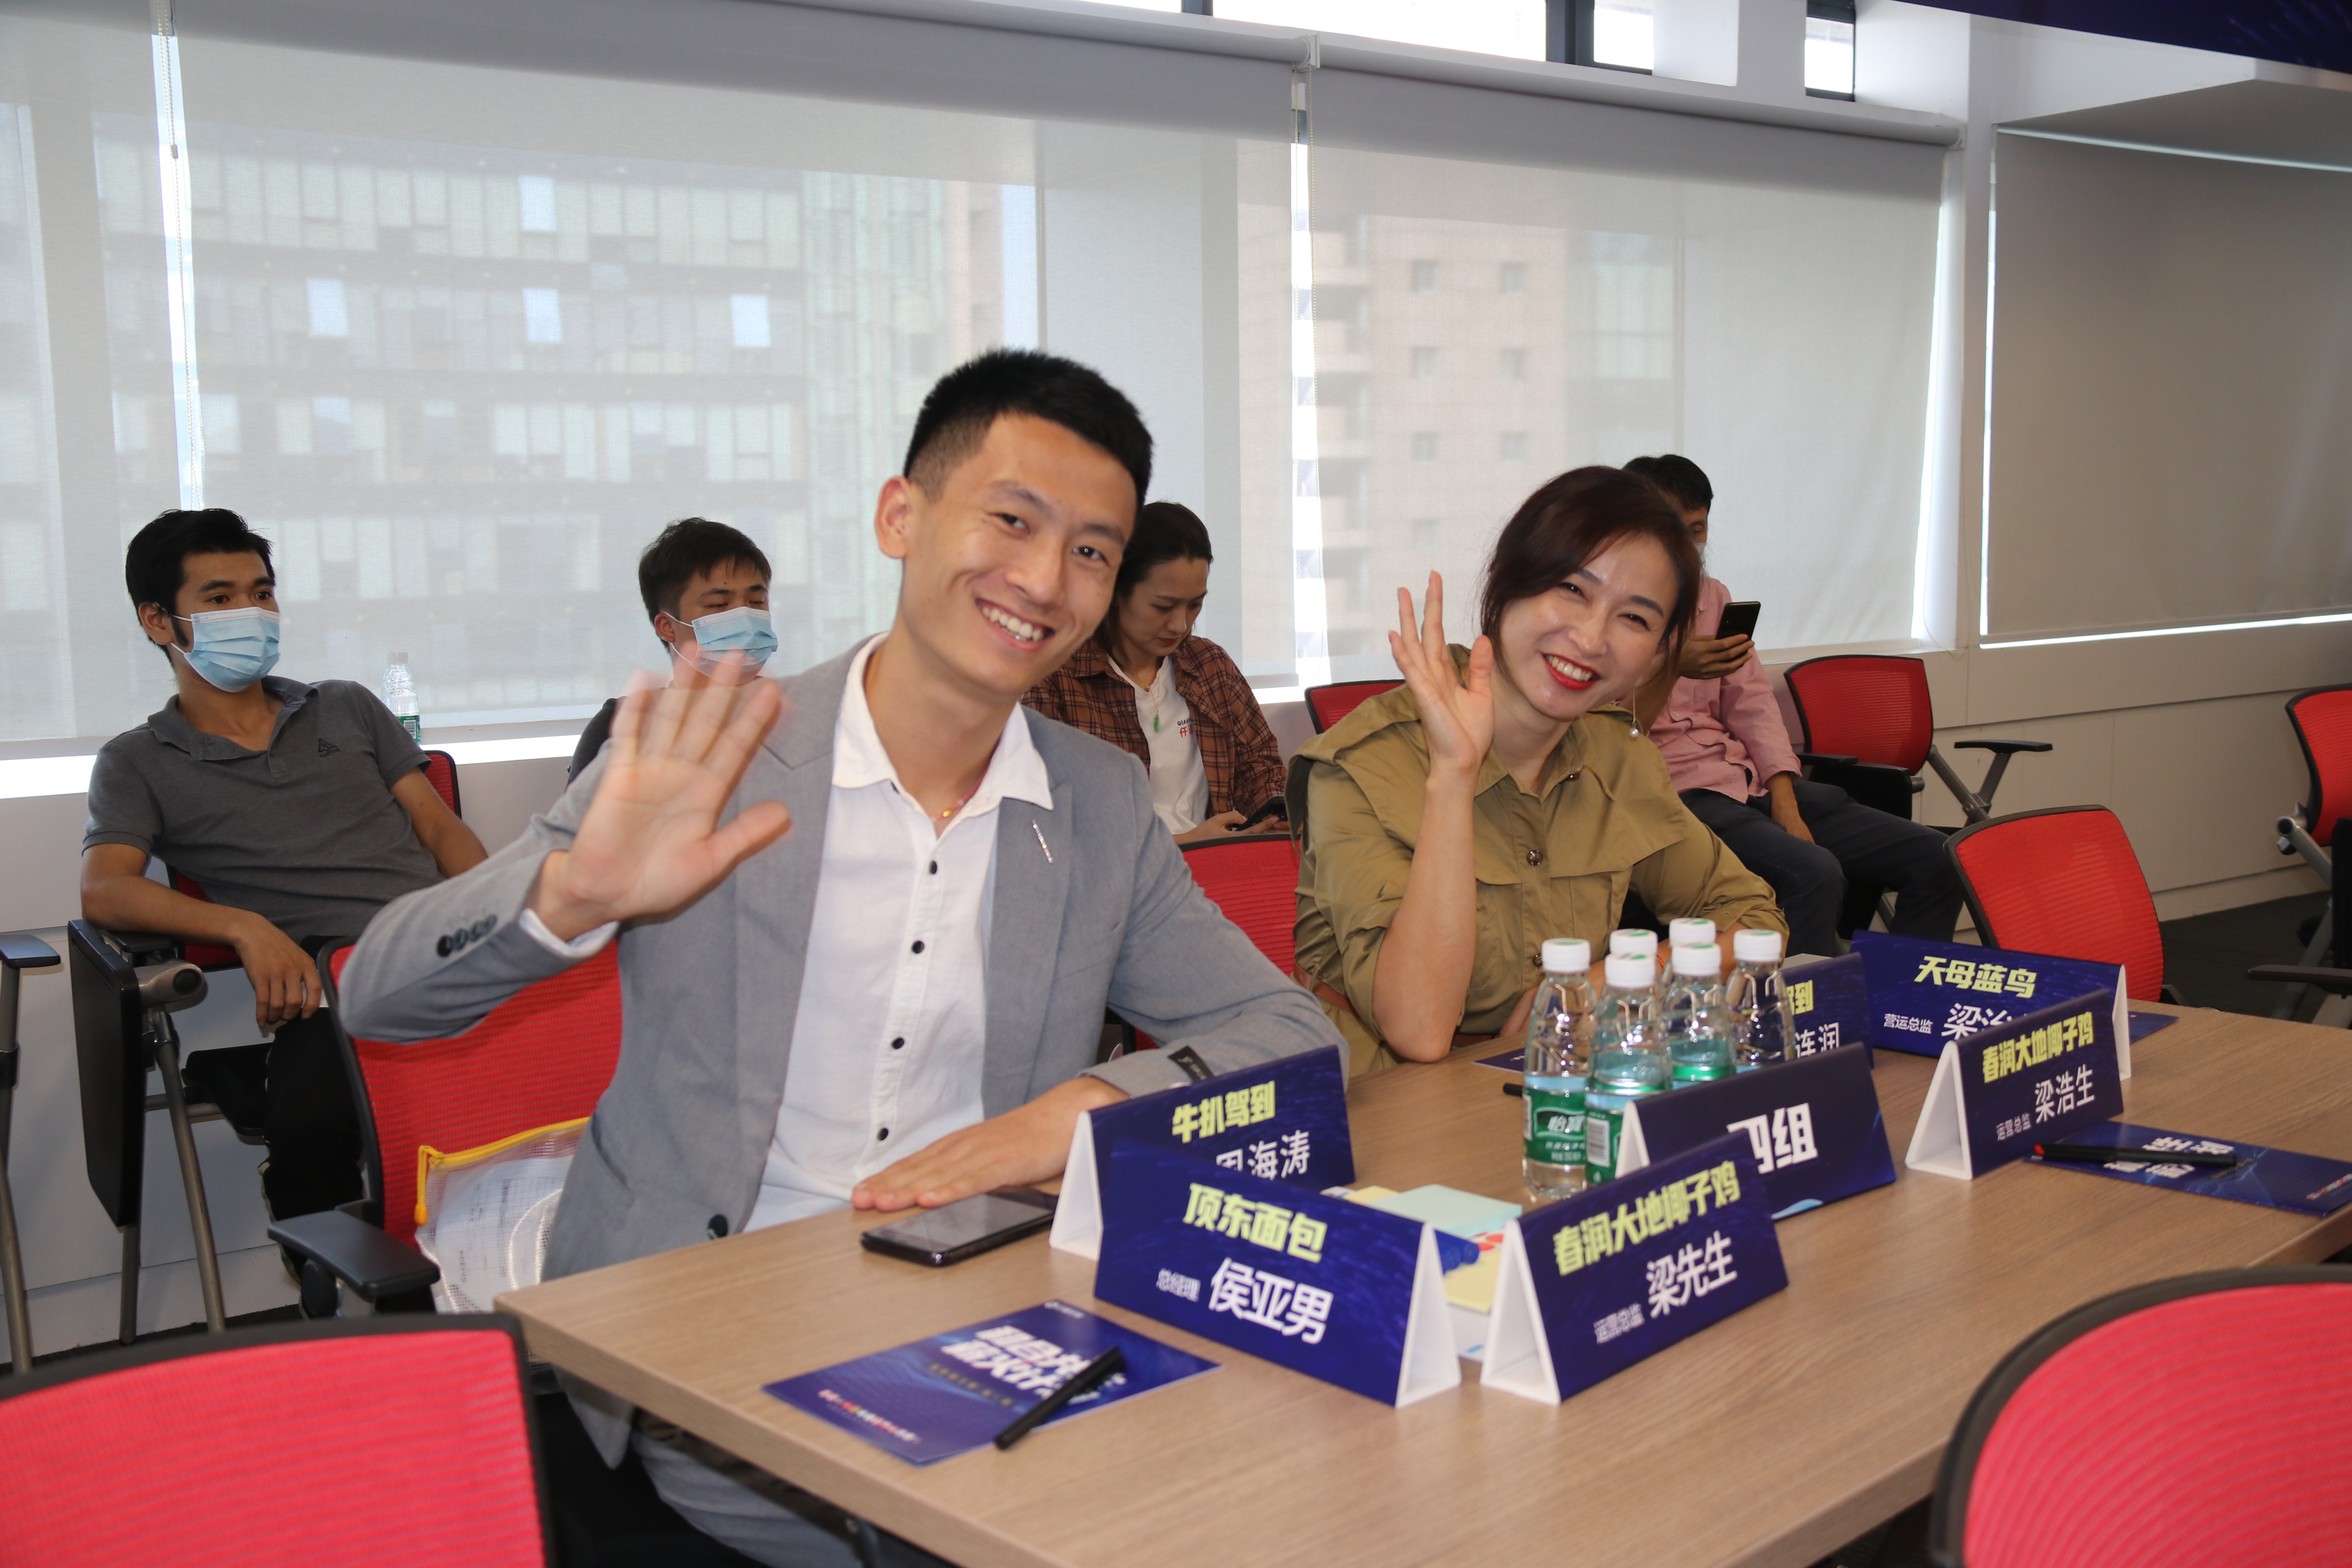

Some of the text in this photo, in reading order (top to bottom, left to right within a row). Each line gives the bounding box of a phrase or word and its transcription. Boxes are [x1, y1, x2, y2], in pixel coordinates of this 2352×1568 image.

[1914, 956, 2037, 998] 天母蓝鸟
[1884, 1013, 1933, 1034] 营运总监
[1983, 1011, 2094, 1083] 春润大地椰子鸡
[1172, 1080, 1276, 1143] 牛扒驾到
[1996, 1063, 2095, 1141] 运营总监 梁浩生
[1182, 1182, 1328, 1263] 顶东面包
[1553, 1160, 1741, 1276] 春润大地椰子鸡
[1208, 1257, 1334, 1345] 侯亚男
[1646, 1230, 1738, 1319] 梁先生
